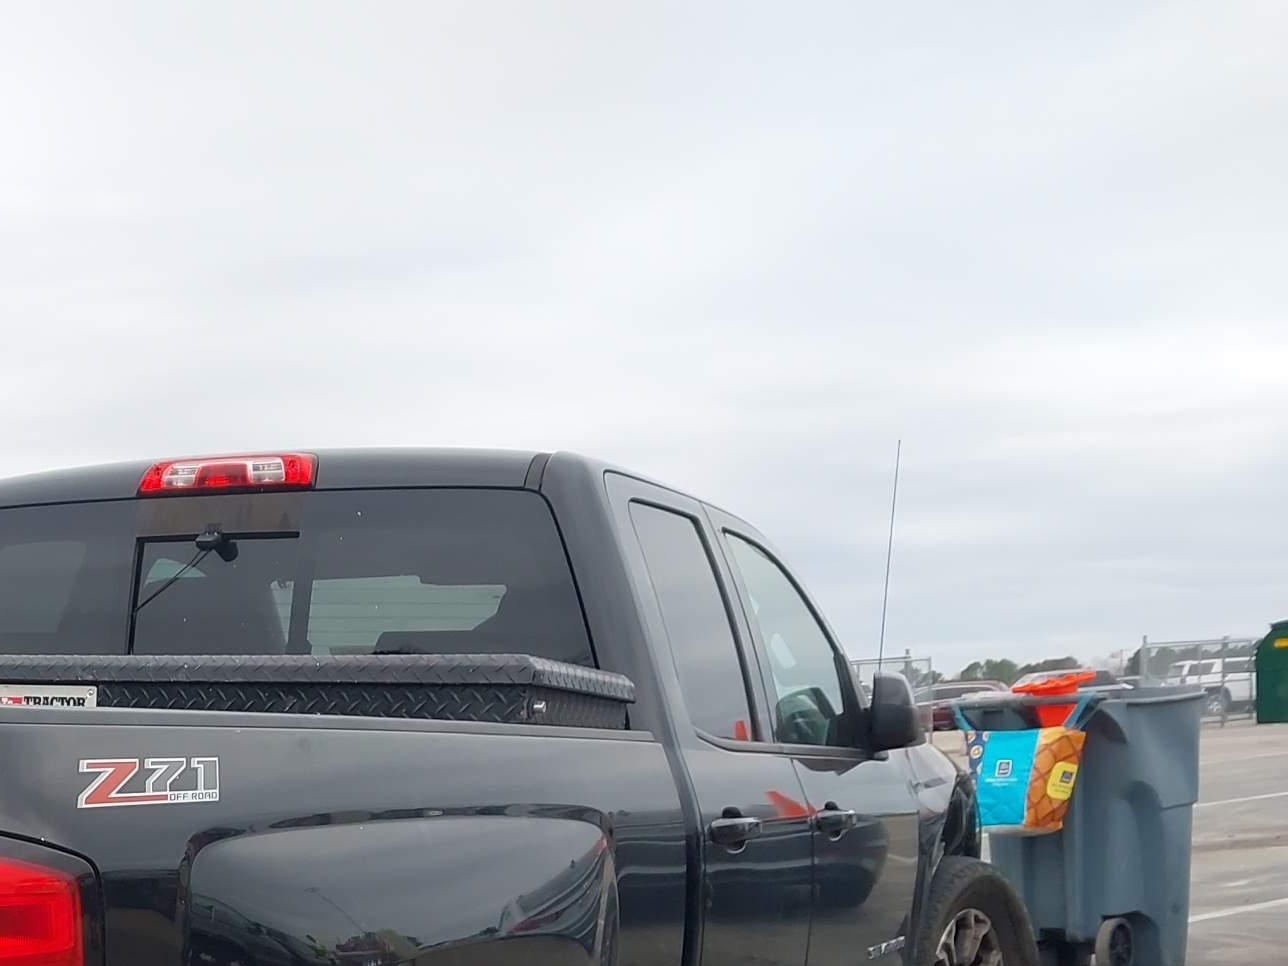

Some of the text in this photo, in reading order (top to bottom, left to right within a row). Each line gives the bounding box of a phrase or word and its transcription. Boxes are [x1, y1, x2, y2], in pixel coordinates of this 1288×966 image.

[23, 696, 85, 707] TRACTOR
[78, 757, 220, 808] Z71
[169, 791, 218, 801] OFF ROAD
